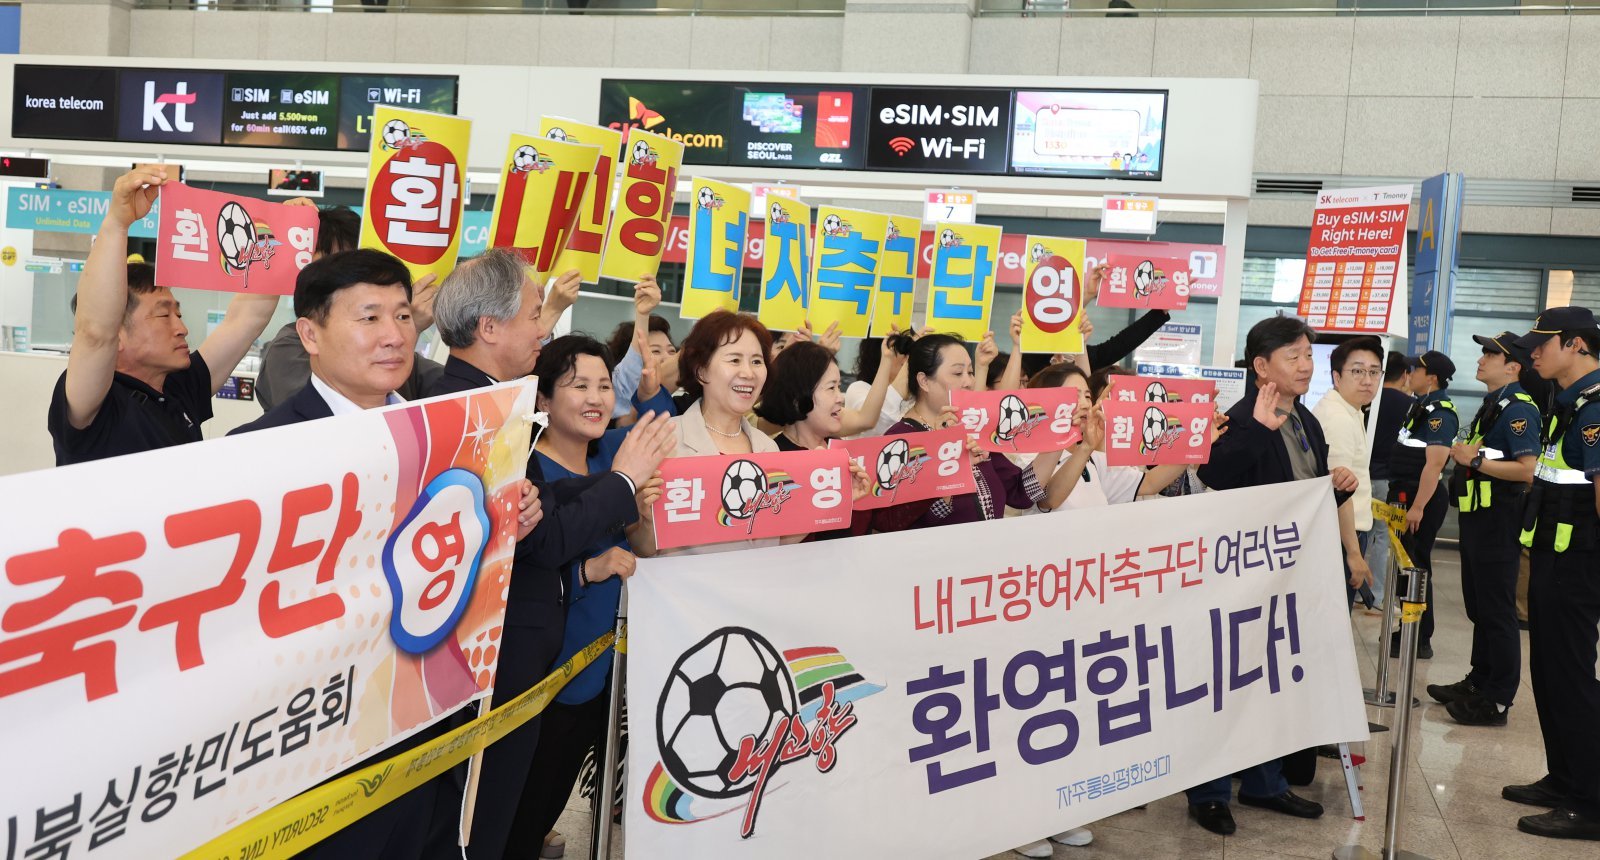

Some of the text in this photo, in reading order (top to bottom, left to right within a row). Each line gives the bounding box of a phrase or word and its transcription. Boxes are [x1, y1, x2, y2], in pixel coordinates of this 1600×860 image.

[25, 94, 104, 111] korea telecom
[143, 80, 197, 133] kt
[244, 88, 329, 105] SIM eSIM
[383, 87, 421, 104] Wi-Fi
[231, 124, 244, 132] for
[246, 123, 271, 133] 60min
[310, 126, 328, 136] off)
[240, 111, 260, 120] Just
[262, 111, 277, 121] add
[747, 141, 793, 152] DISCOVER
[920, 137, 986, 159] Wi-Fi
[18, 194, 111, 215] SIM eSIM
[384, 156, 459, 248] 환
[945, 205, 955, 219] 7
[1320, 195, 1332, 204] SK
[1332, 196, 1360, 204] telecom
[1383, 192, 1408, 200] Tmoney
[35, 217, 91, 229] Unlimited Data
[171, 208, 209, 262] 환
[287, 226, 314, 271] 영
[1316, 213, 1341, 228] Buy
[1321, 227, 1393, 244] Right Here!
[1418, 198, 1435, 252] A
[690, 205, 748, 301] 녀
[764, 220, 810, 309] 자
[1311, 247, 1319, 255] To
[1320, 247, 1332, 255] Get
[1332, 247, 1347, 255] Free
[1379, 245, 1398, 254] card!
[816, 231, 880, 315] 축
[879, 236, 916, 316] 구
[932, 244, 993, 320] 단
[1109, 266, 1128, 294] 환
[1172, 270, 1190, 297] 영
[1031, 265, 1075, 324] 영
[961, 407, 990, 440] 환
[1050, 402, 1078, 434] 영
[1111, 415, 1135, 449] 환
[1188, 417, 1209, 448] 영
[937, 439, 963, 477] 영
[663, 477, 706, 523] 환
[809, 466, 843, 509] 영
[0, 471, 463, 703] 축구단 영
[912, 520, 1302, 636] 내고향여자축구단 여러분
[905, 592, 1305, 796] 환영합니다!
[6, 664, 356, 860] 북실향민도움회
[1056, 754, 1171, 810] 자주통일평화연대
